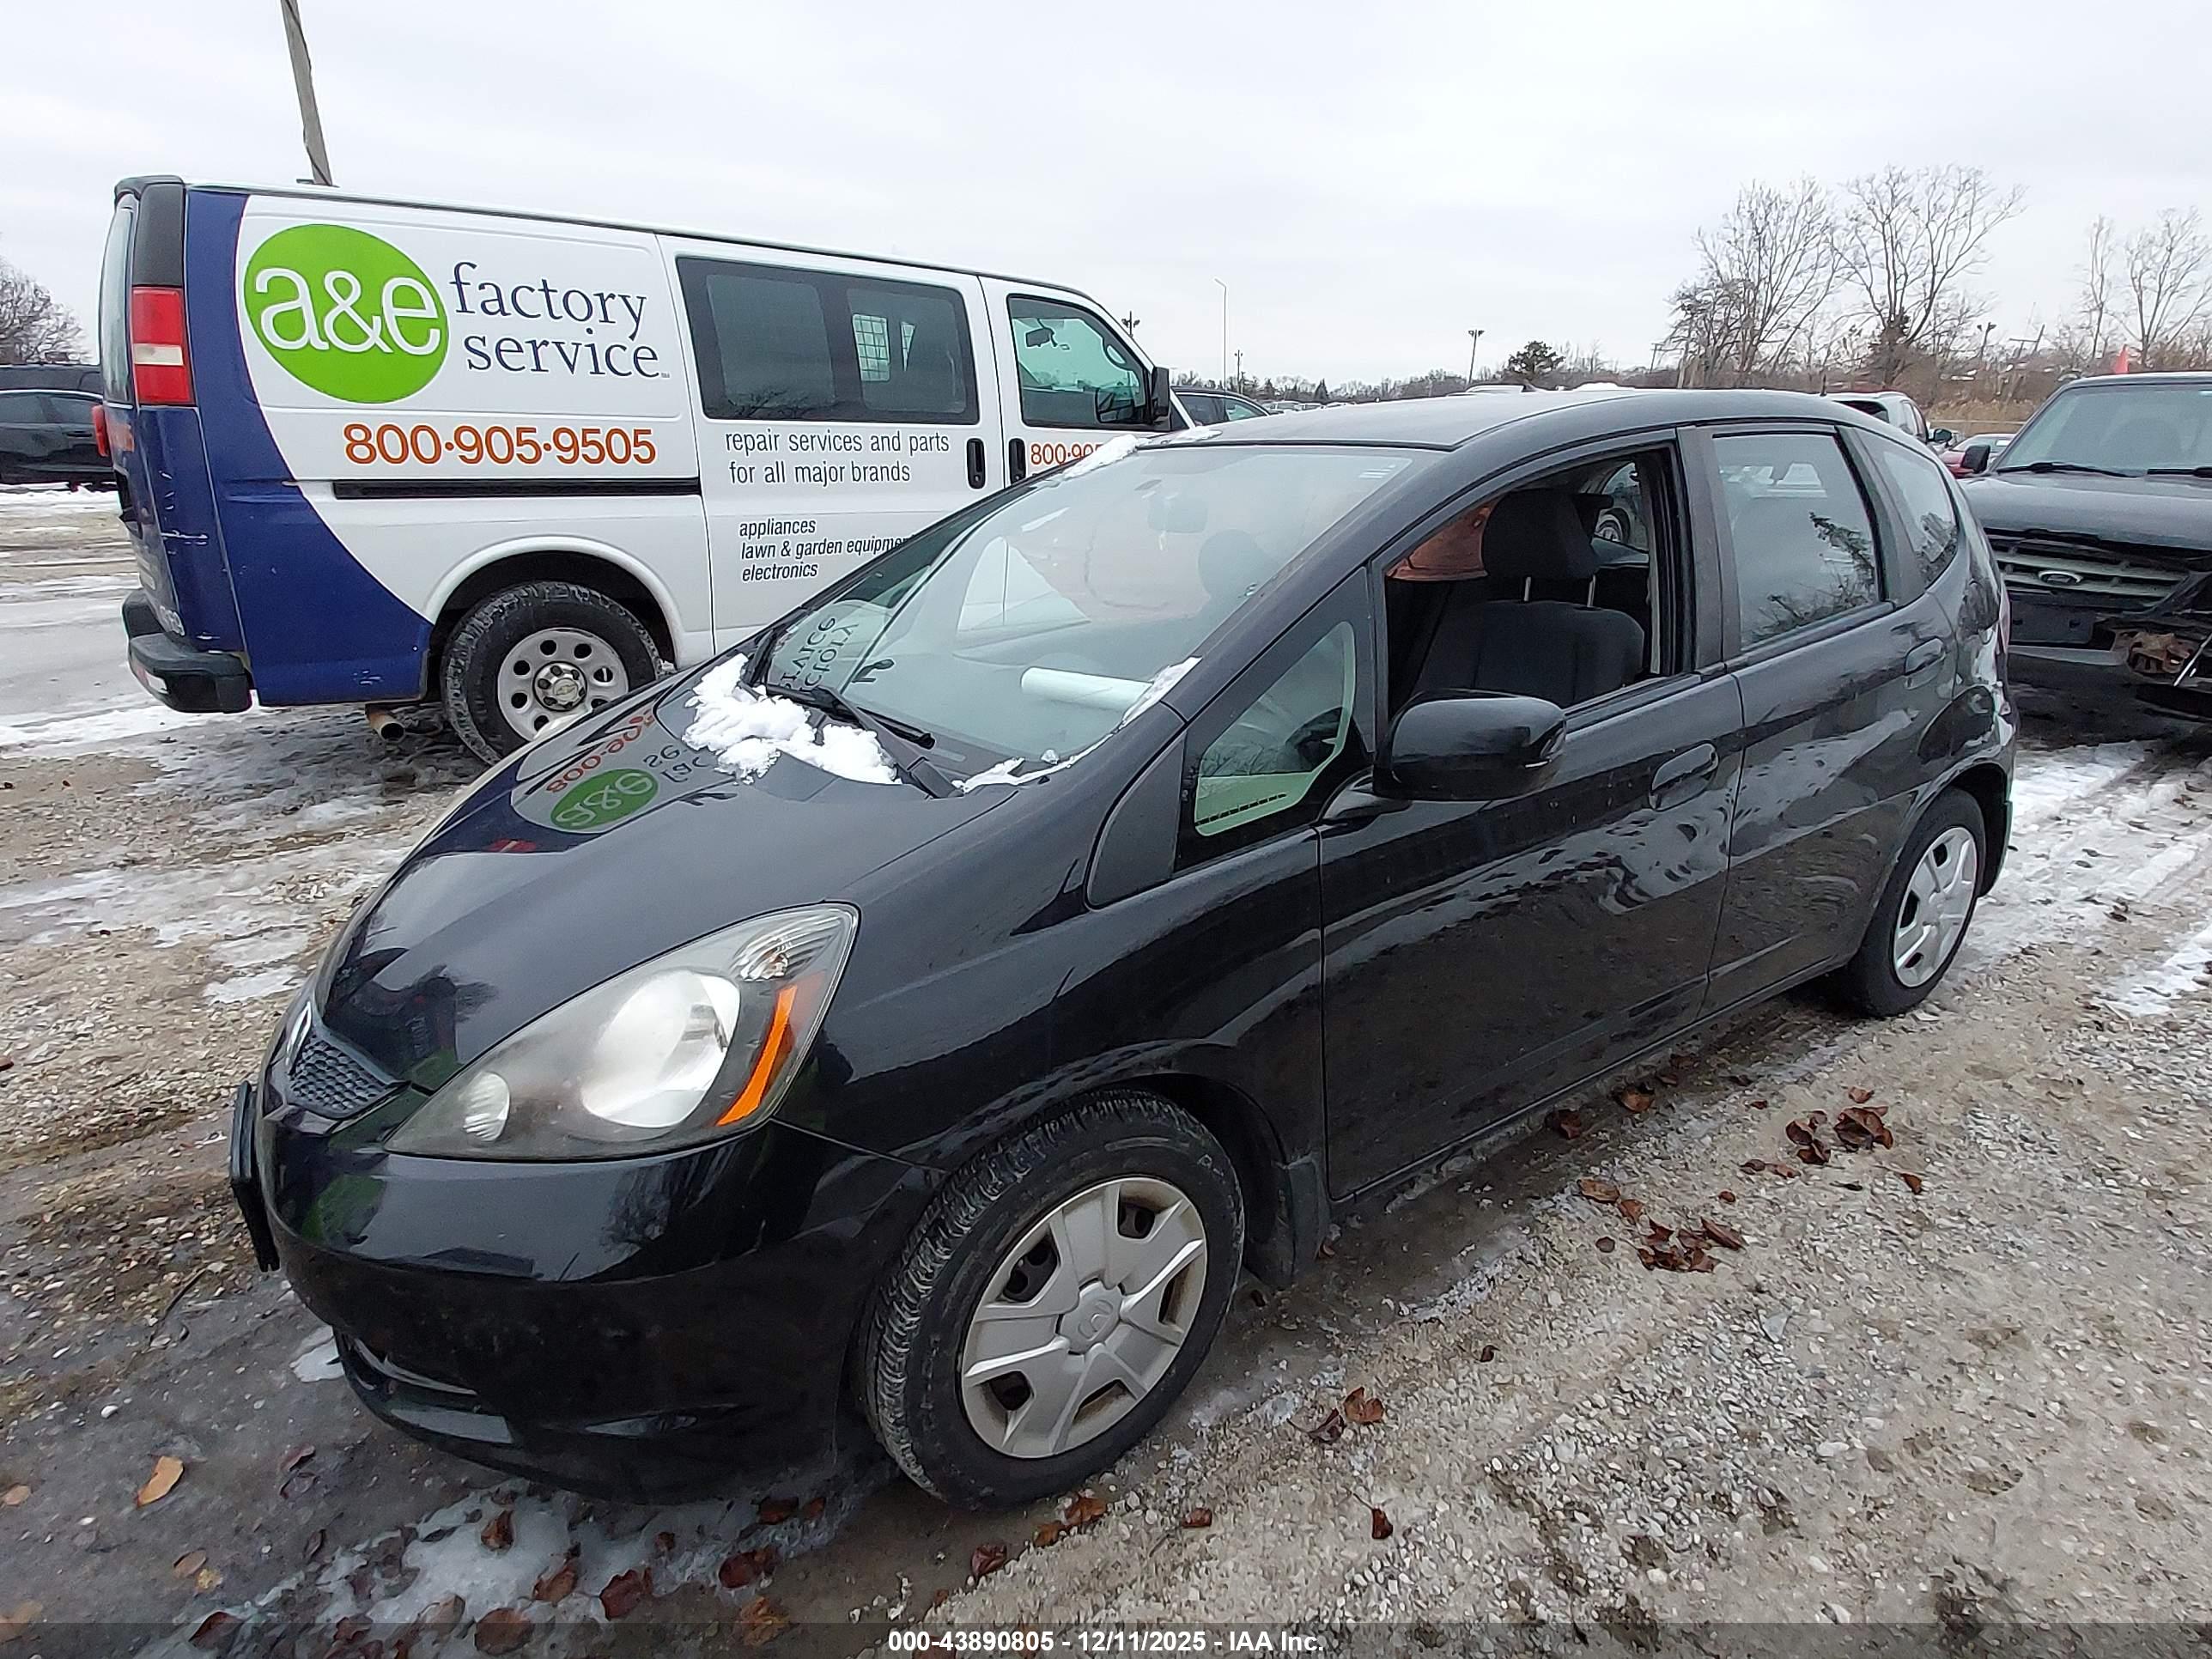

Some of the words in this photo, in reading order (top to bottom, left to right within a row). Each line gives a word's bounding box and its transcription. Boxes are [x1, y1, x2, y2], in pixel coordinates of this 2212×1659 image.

[255, 267, 441, 356] a&e
[449, 261, 647, 342] factory
[463, 327, 660, 378] service
[726, 428, 781, 456] repair
[788, 428, 863, 452] services
[870, 430, 901, 452] and
[908, 431, 950, 456] parts
[729, 460, 756, 483] for
[764, 460, 786, 483] all
[794, 460, 846, 487] major
[851, 460, 910, 482] brands
[739, 518, 816, 539] appliances
[741, 543, 775, 559] lawn
[781, 541, 791, 556] &
[795, 538, 842, 560] garden
[742, 562, 818, 581] electronics
